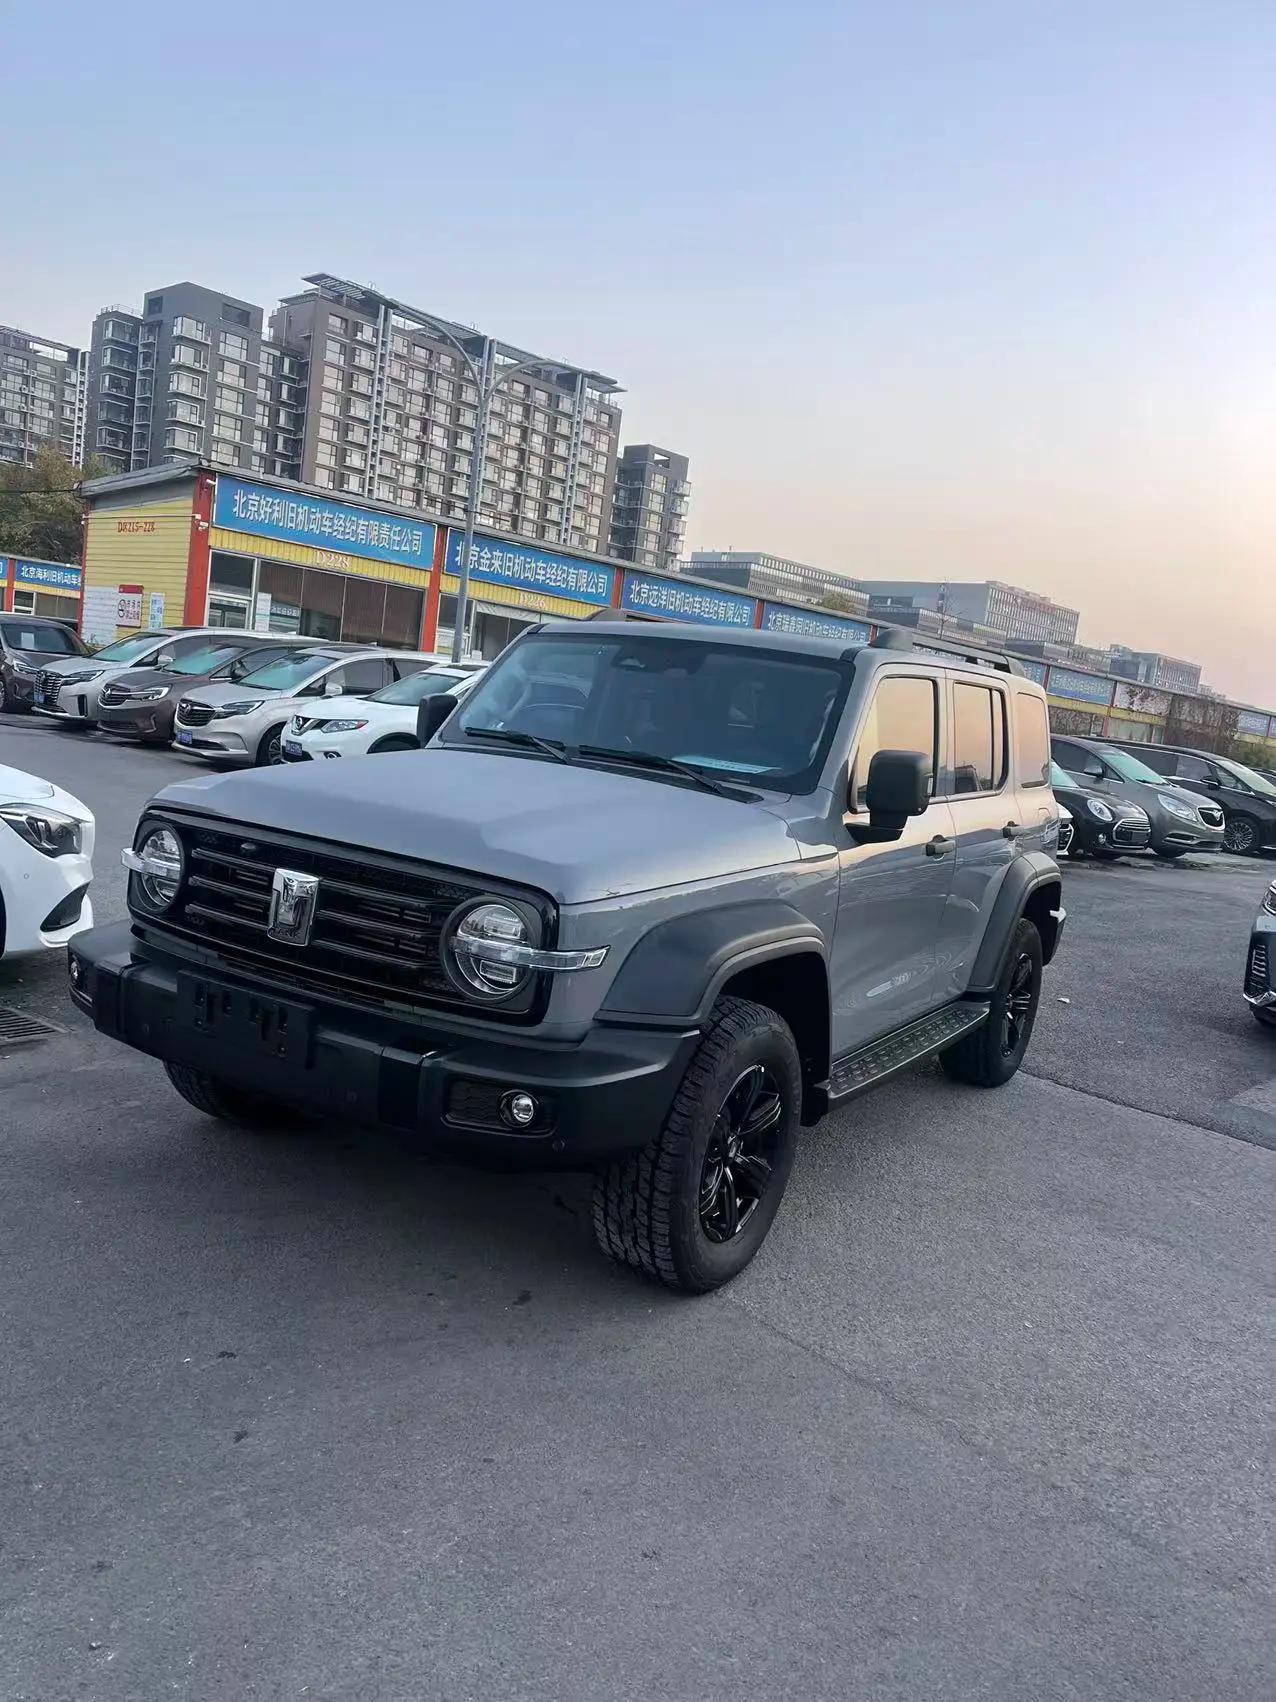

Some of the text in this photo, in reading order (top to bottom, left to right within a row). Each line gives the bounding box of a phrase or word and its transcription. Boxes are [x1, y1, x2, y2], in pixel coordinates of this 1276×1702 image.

[233, 489, 423, 555] 北京好利旧机动车经纪有限责任公司
[629, 580, 751, 626] 北京远洋旧机动车经纪有限公司
